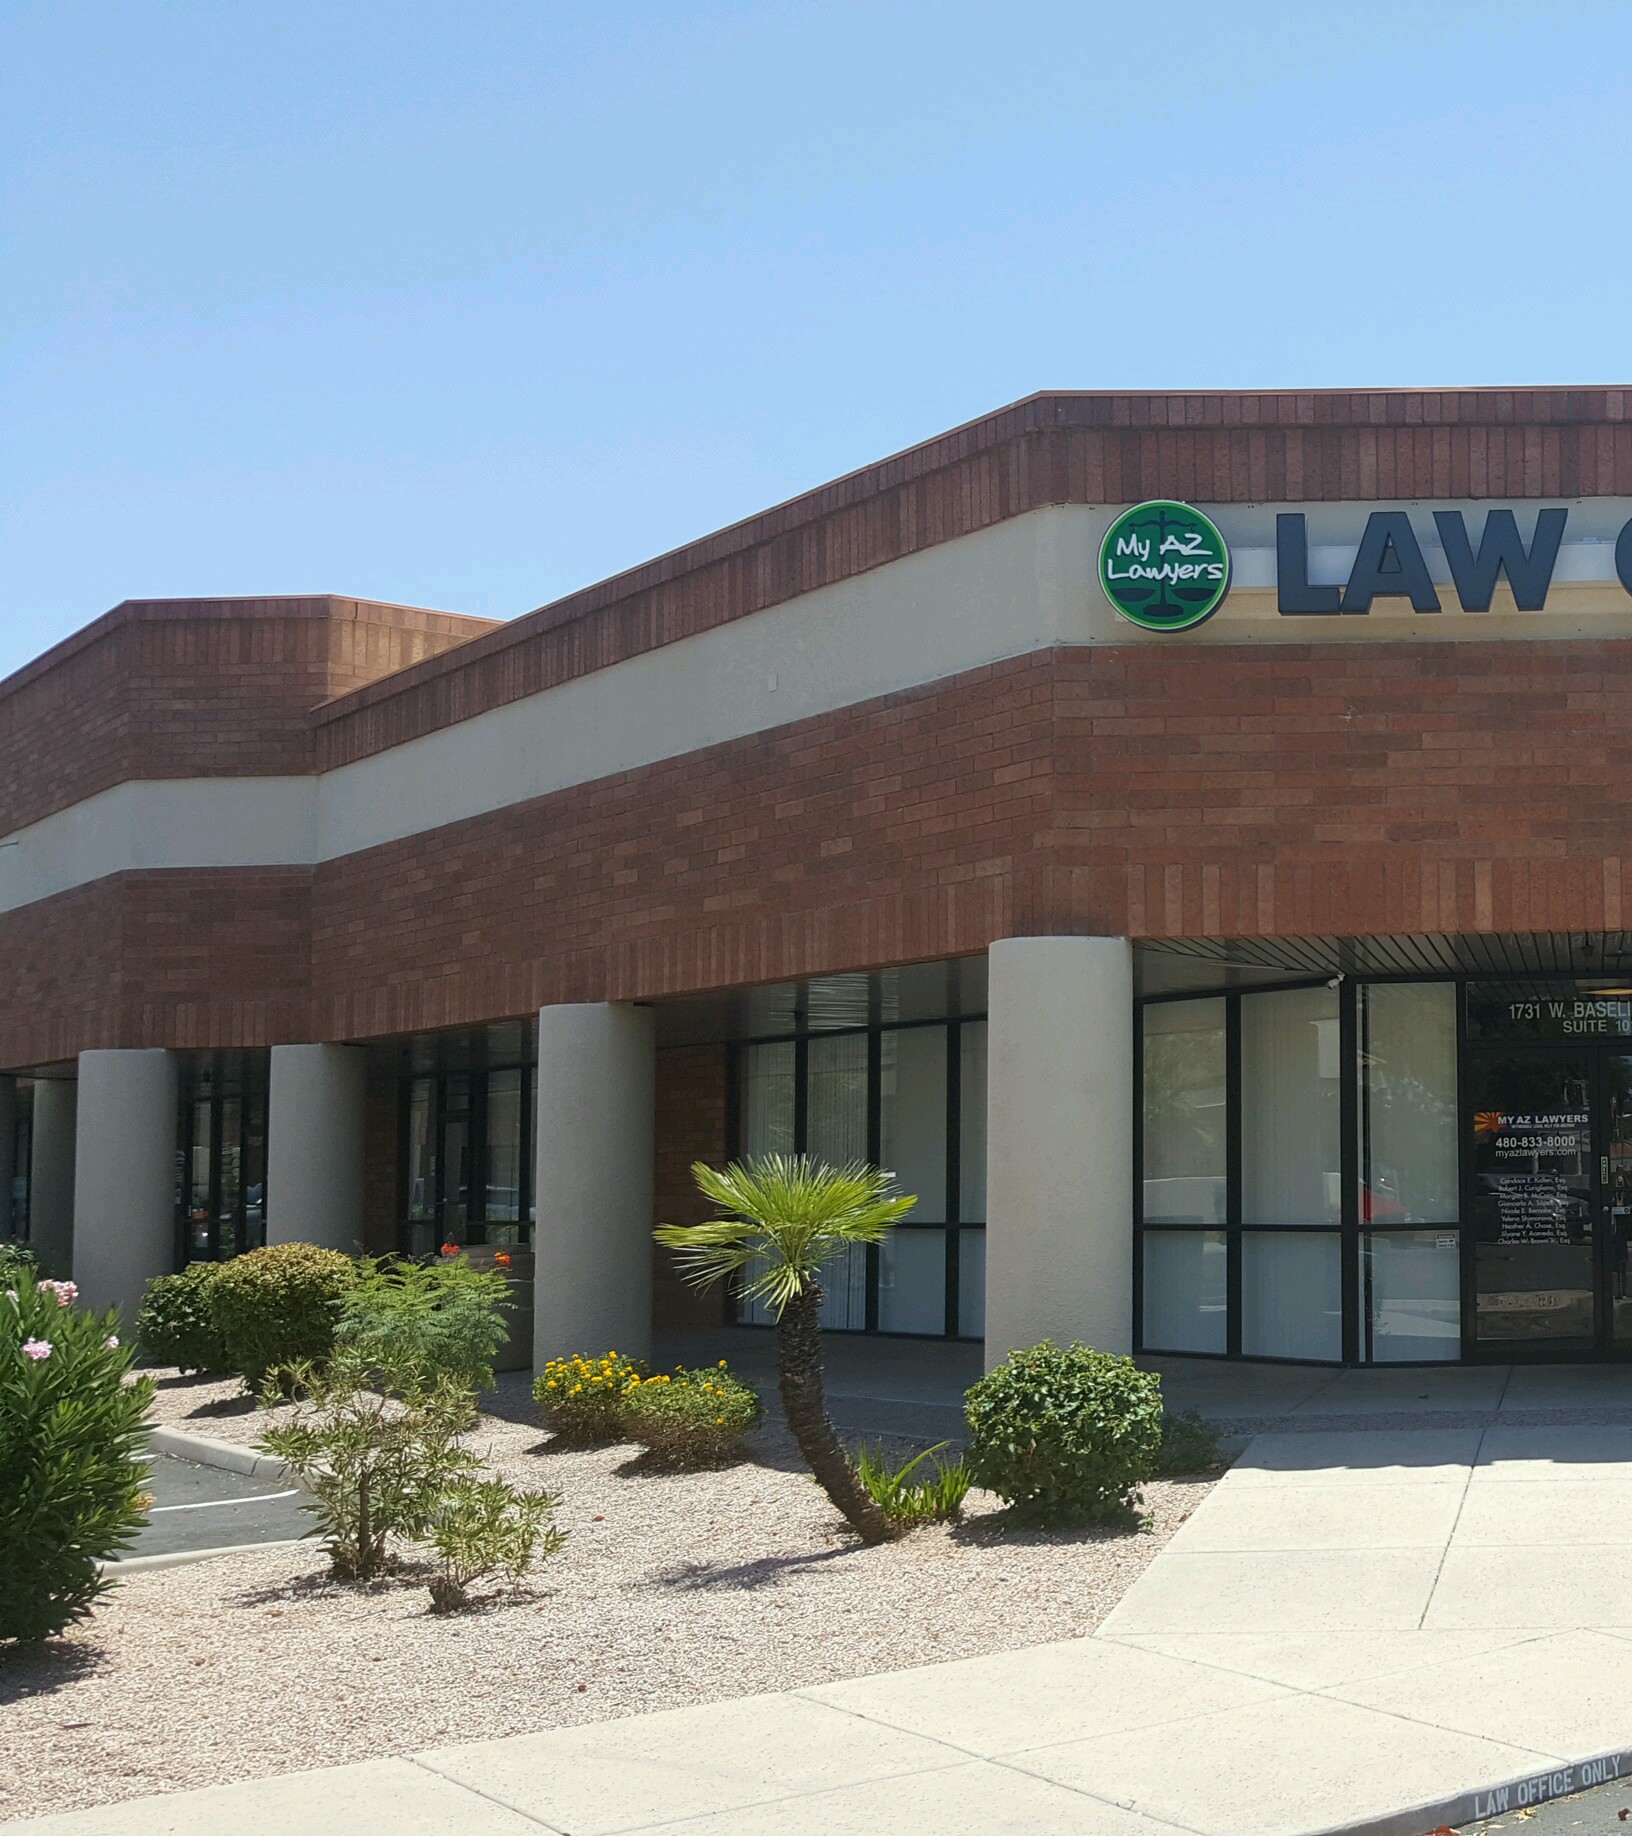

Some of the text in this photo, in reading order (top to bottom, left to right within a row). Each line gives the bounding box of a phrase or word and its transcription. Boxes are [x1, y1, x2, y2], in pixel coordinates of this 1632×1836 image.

[1116, 533, 1214, 562] My AZ
[1275, 508, 1569, 615] LAW
[1107, 558, 1224, 586] Lawyers
[1508, 1002, 1541, 1020] 1731
[1548, 1002, 1566, 1019] W.
[1562, 1020, 1608, 1033] SUITE
[1497, 1114, 1589, 1125] MY AZ LAWYERS
[1495, 1136, 1576, 1148] 480-833-8000
[1495, 1147, 1576, 1159] myazlawyers.com
[1473, 1754, 1622, 1820] LAW OFFICE ONLY
